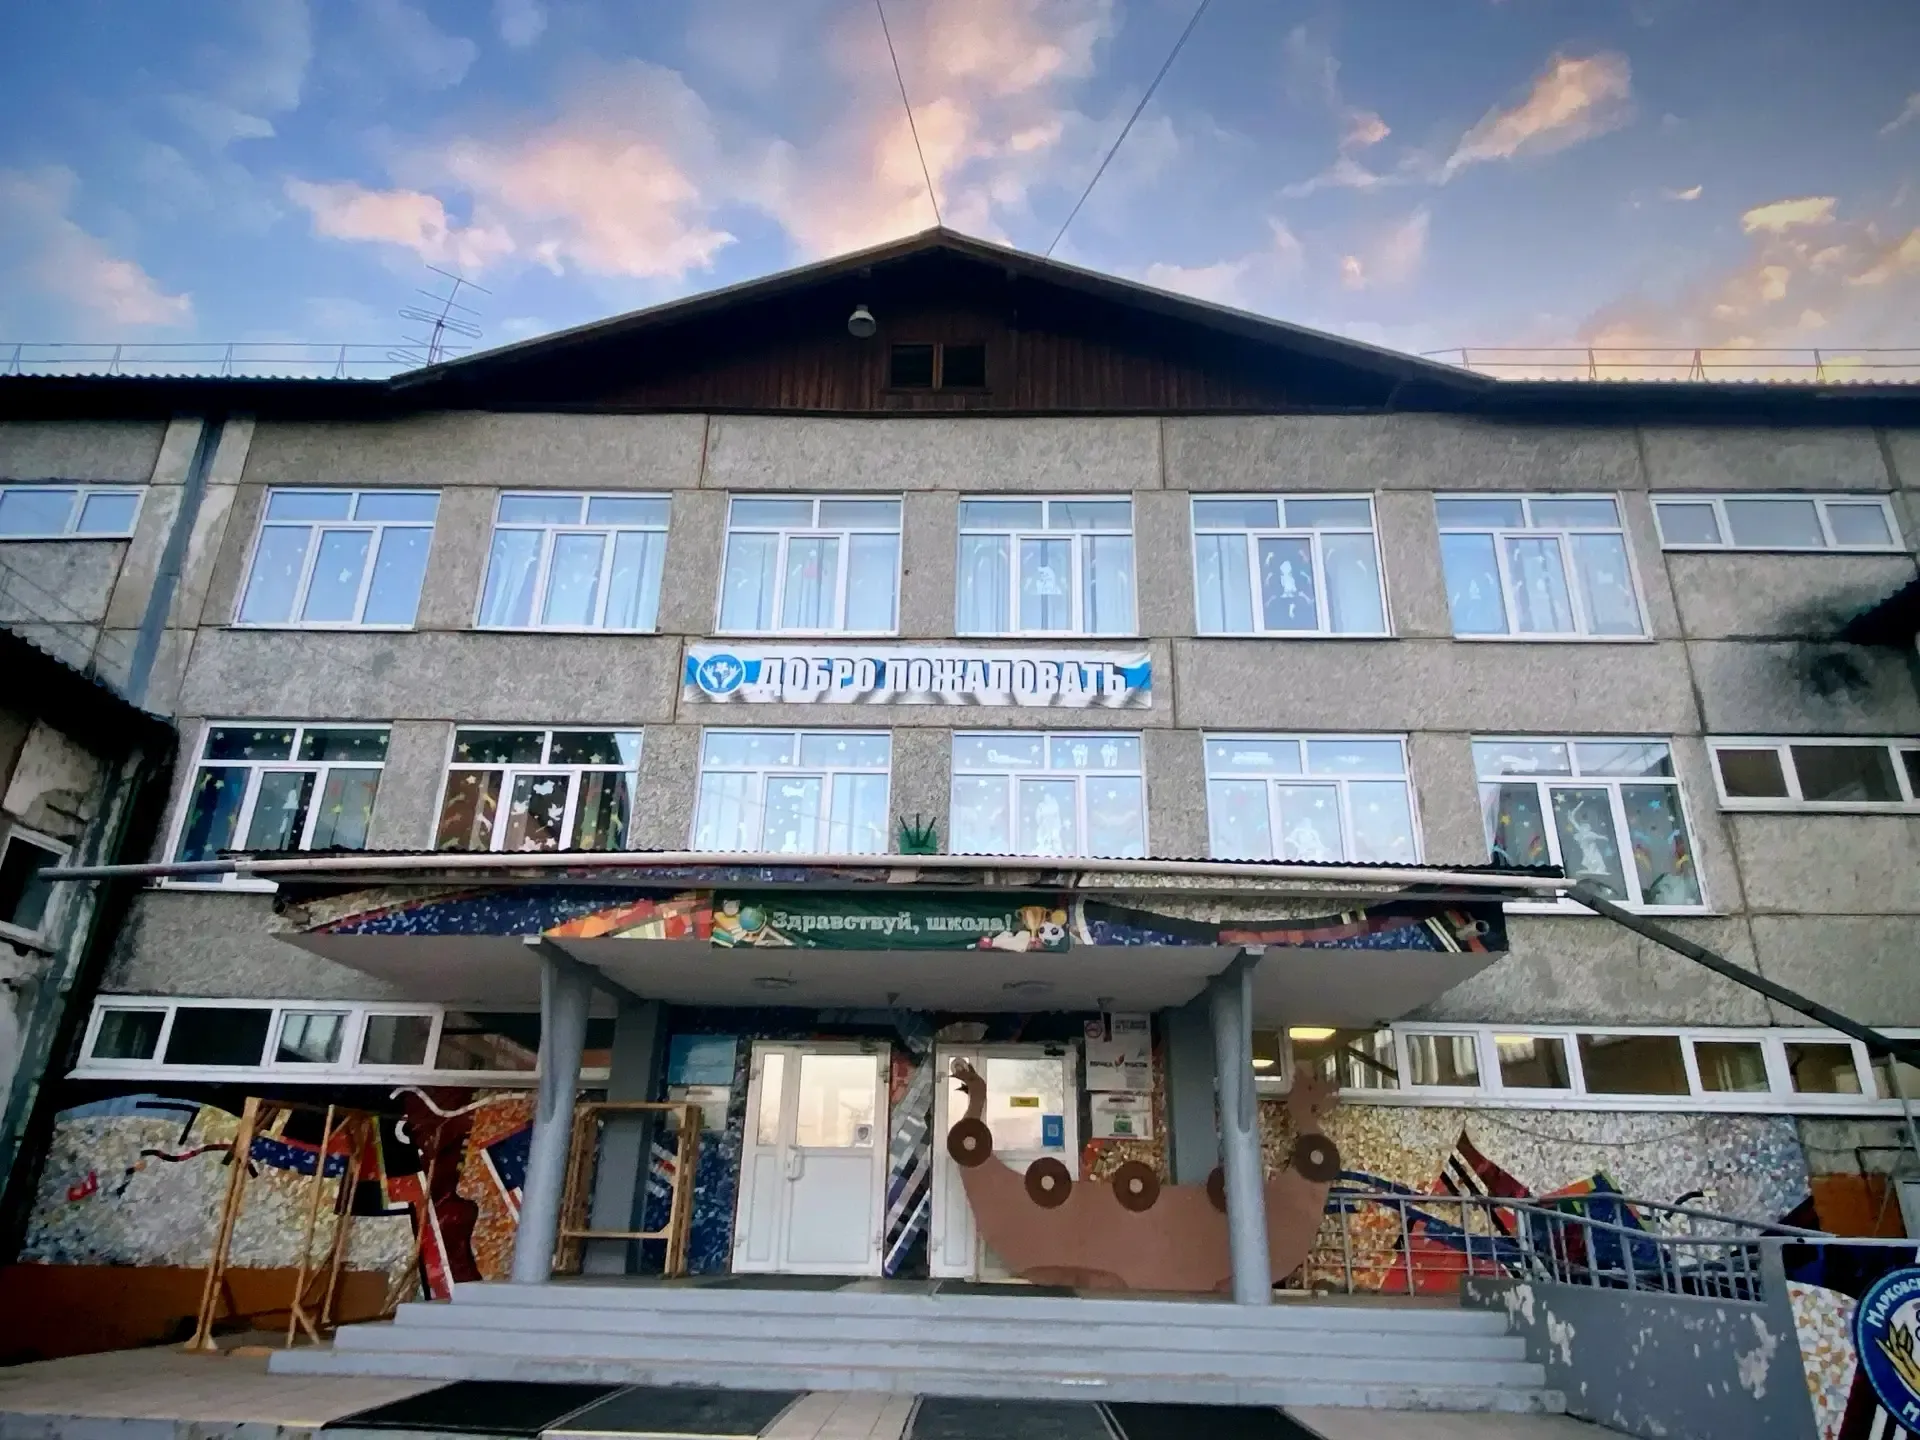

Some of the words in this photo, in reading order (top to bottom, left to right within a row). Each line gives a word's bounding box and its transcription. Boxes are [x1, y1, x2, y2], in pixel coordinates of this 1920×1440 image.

[759, 656, 878, 696] ДОБРО
[883, 657, 1129, 695] ПОЖАЛОВАТЬ
[772, 911, 920, 935] Здравствуй,
[926, 914, 1013, 933] школа!
